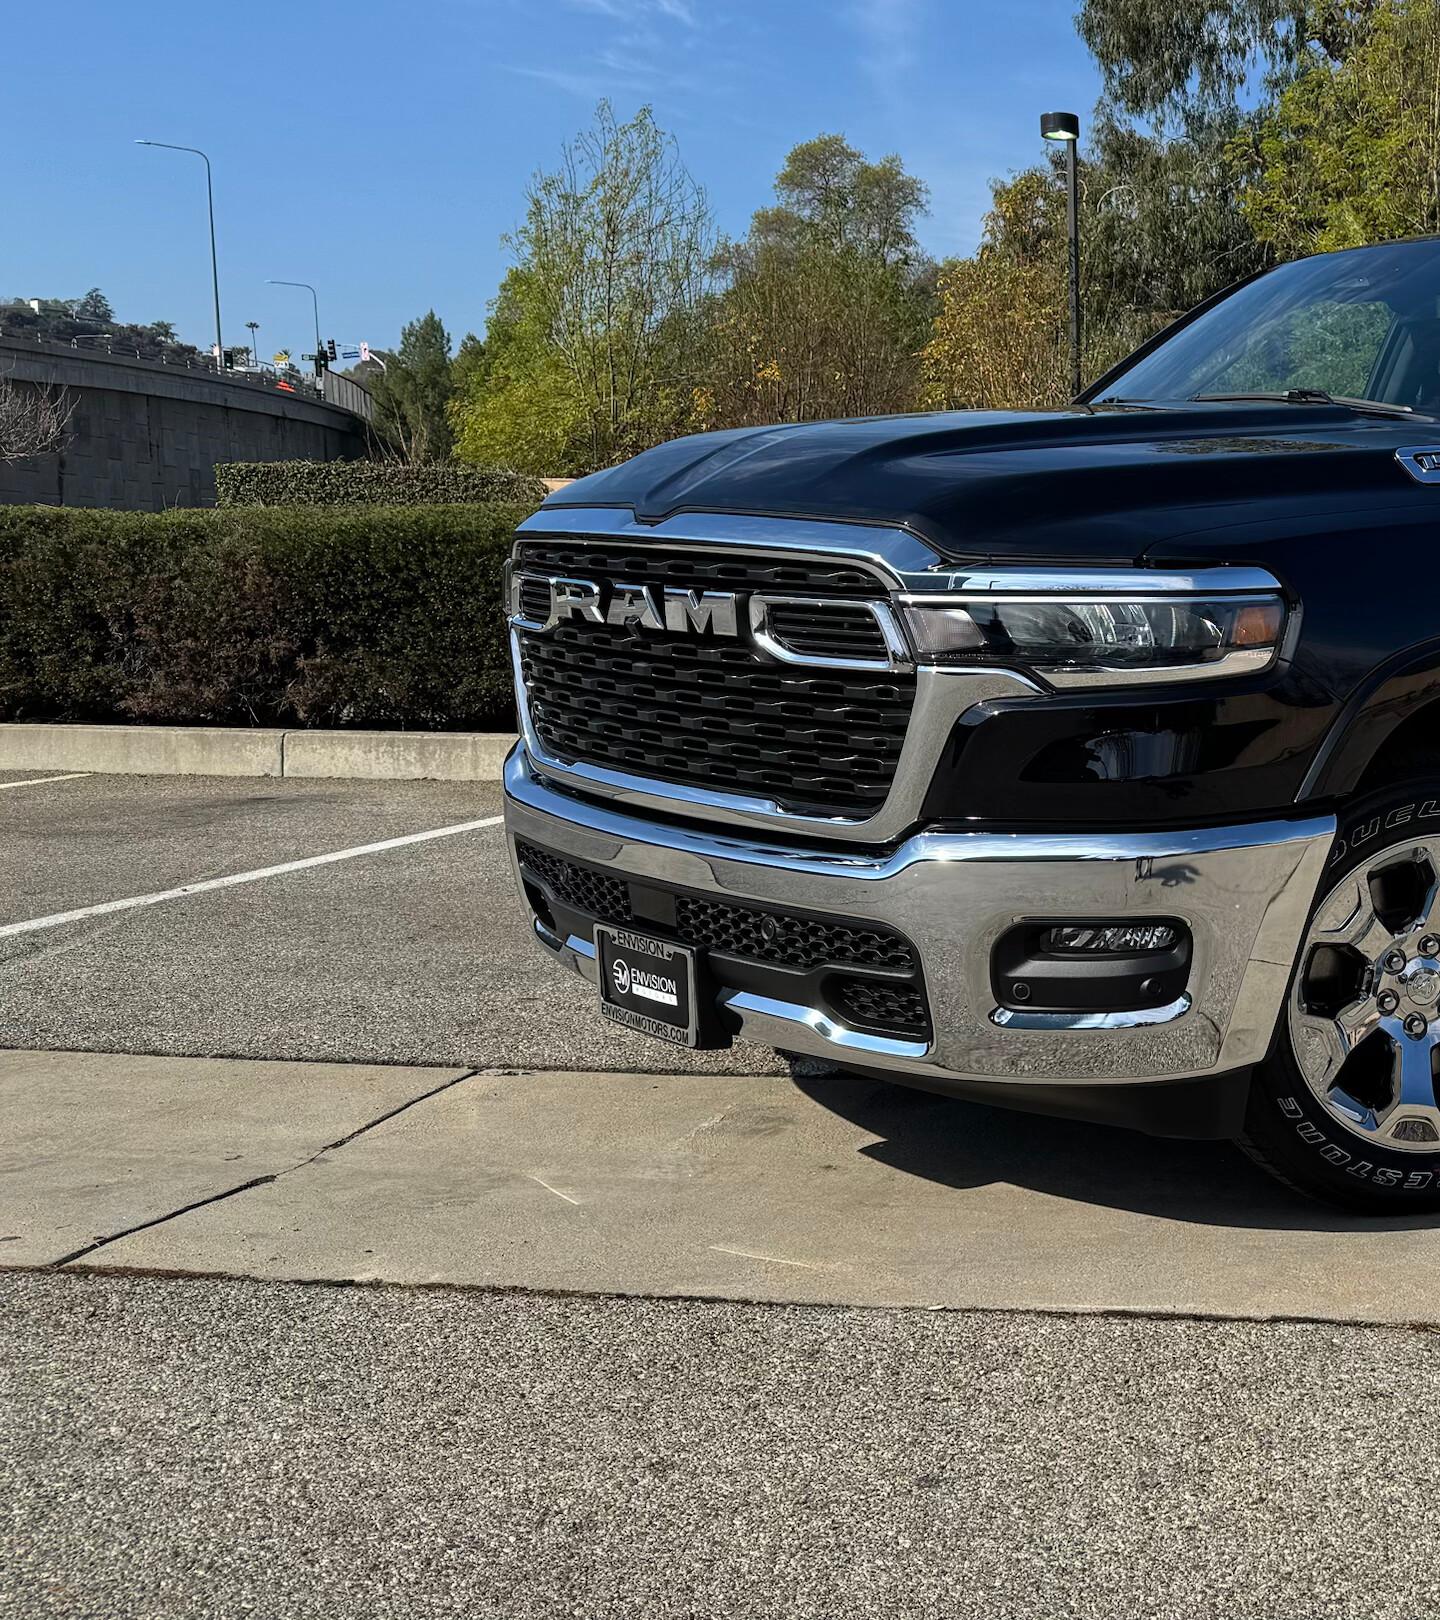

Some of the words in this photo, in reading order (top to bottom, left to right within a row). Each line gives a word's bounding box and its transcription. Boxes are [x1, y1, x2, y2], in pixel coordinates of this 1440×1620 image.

[549, 577, 738, 636] RAM
[616, 930, 665, 959] ENVISION
[631, 968, 677, 995] ENVISION
[601, 1004, 689, 1045] ENVISIONMOTORS.COM
